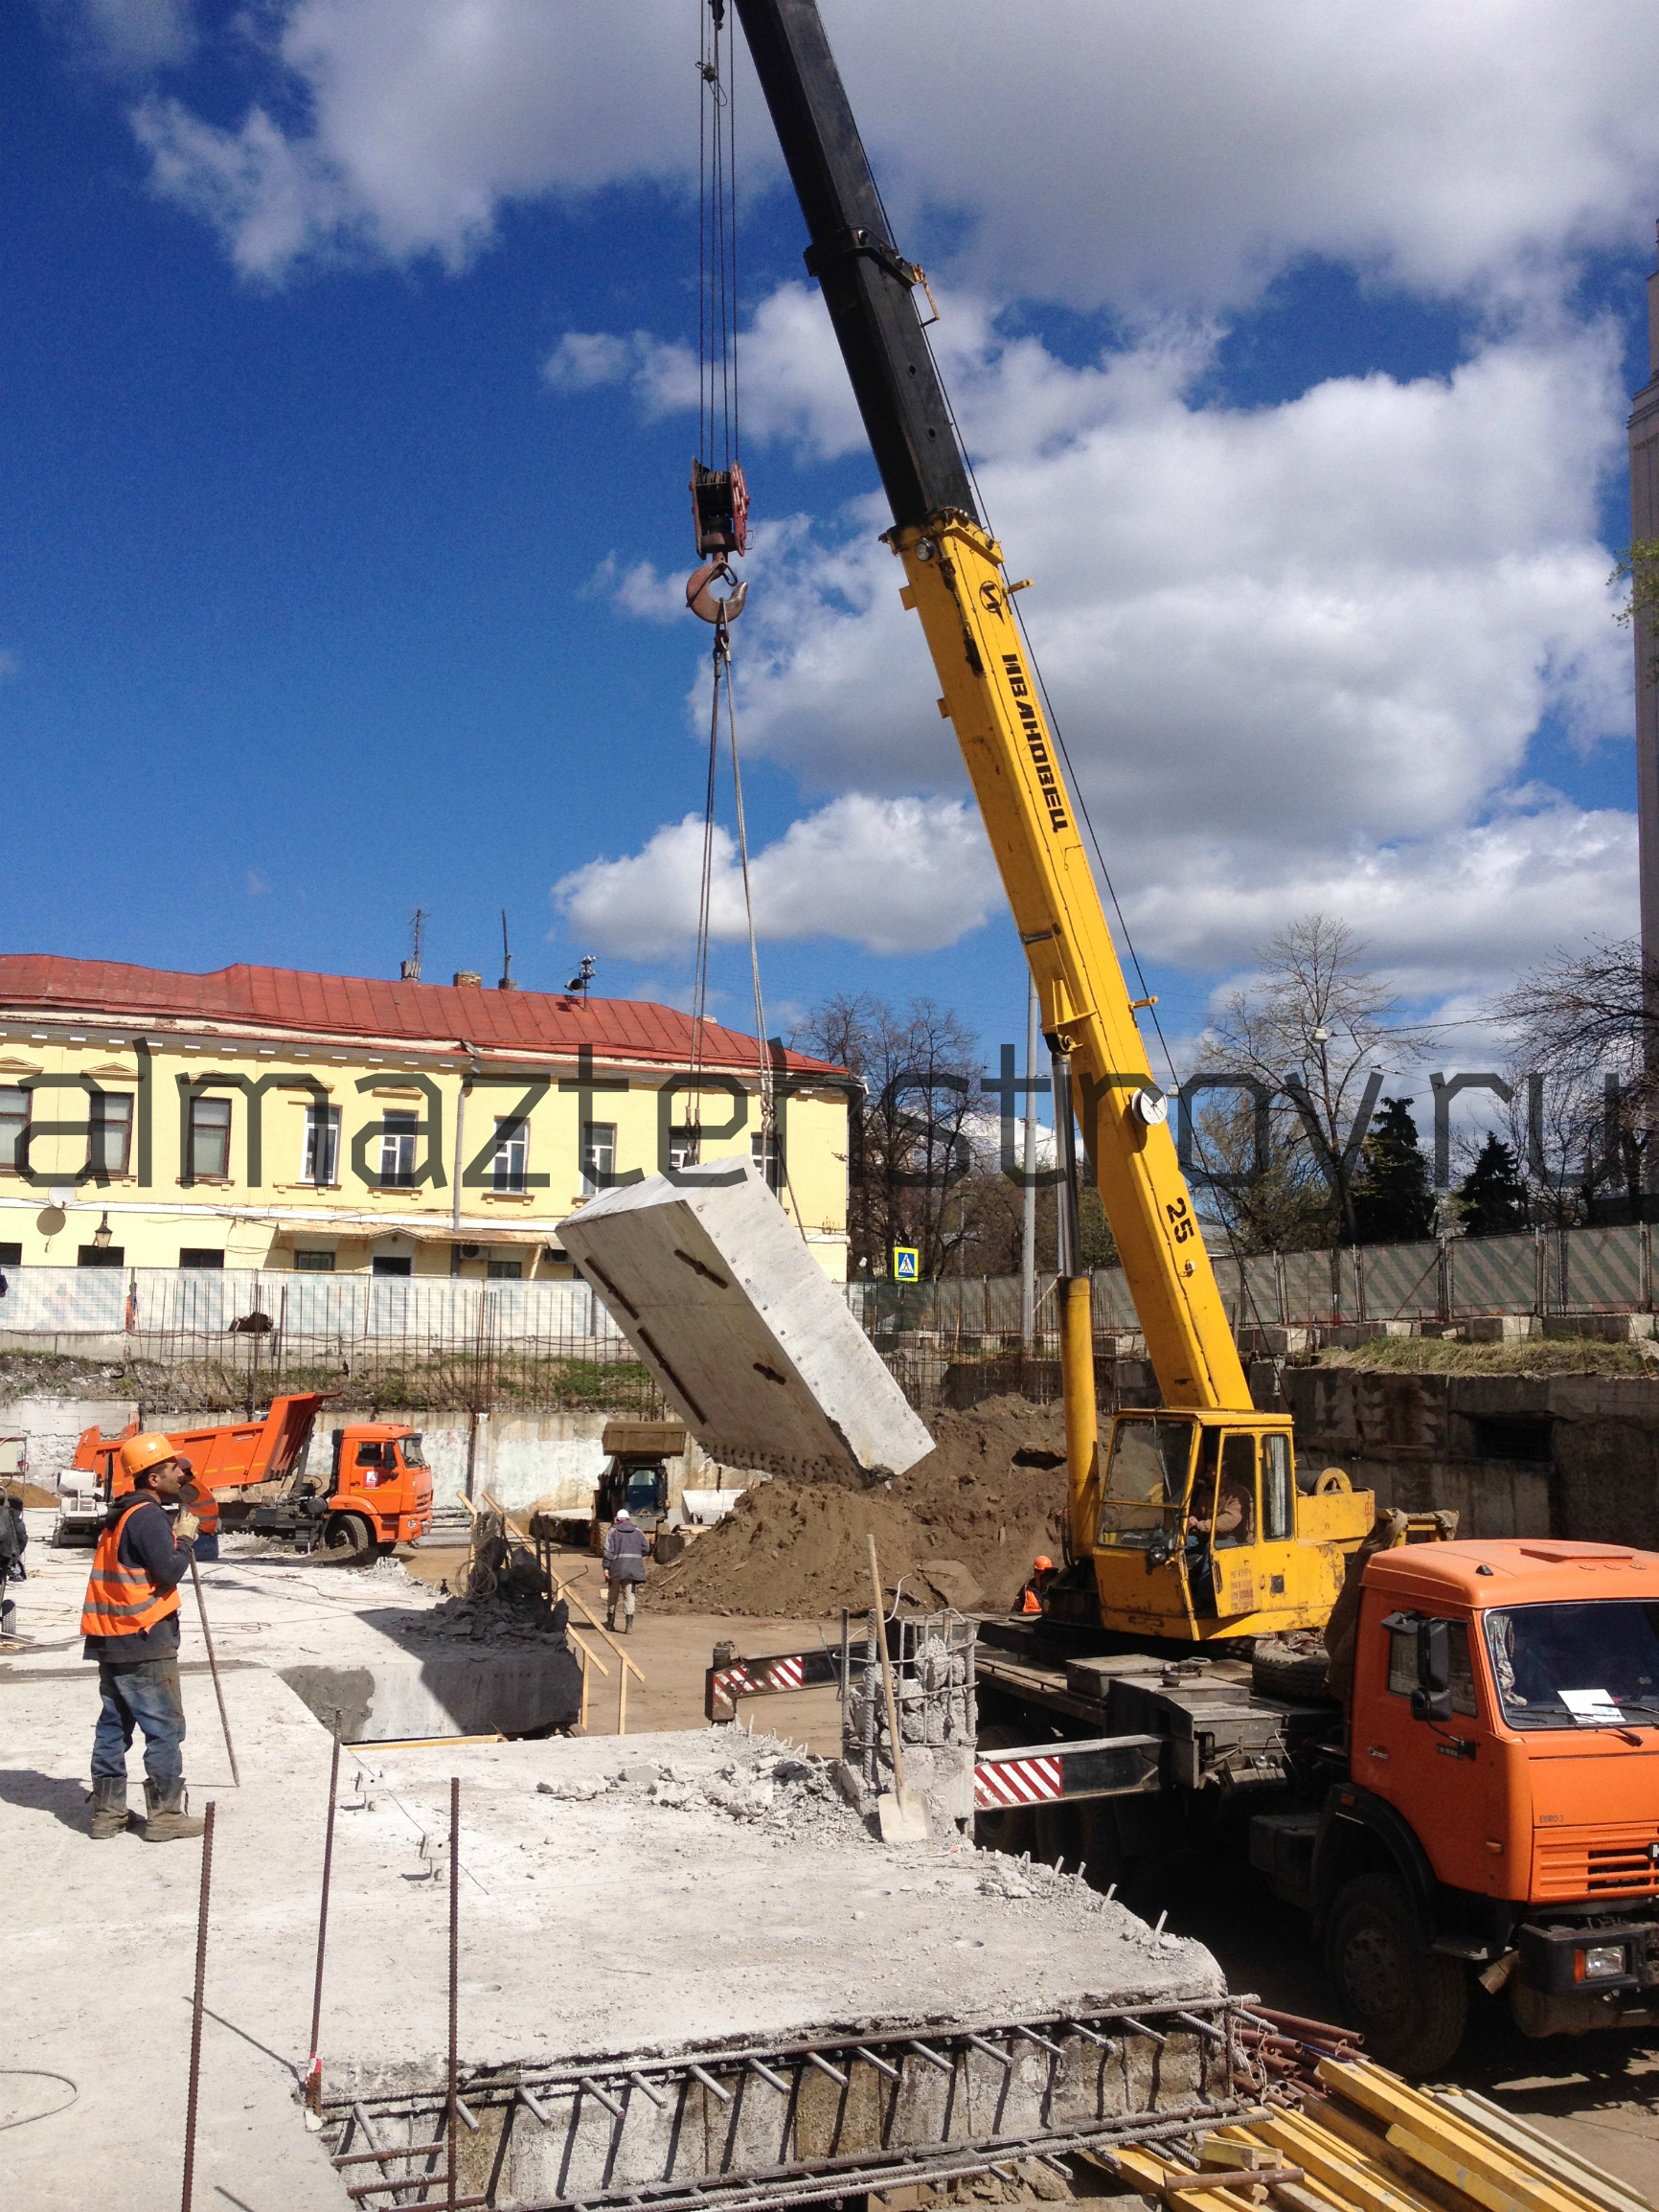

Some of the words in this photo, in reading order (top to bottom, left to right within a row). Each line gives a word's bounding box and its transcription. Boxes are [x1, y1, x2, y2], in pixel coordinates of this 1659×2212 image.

[1002, 653, 1069, 833] ИВАНОВЕЦ
[1166, 1197, 1195, 1244] 25
[1539, 1814, 1558, 1824] EURO
